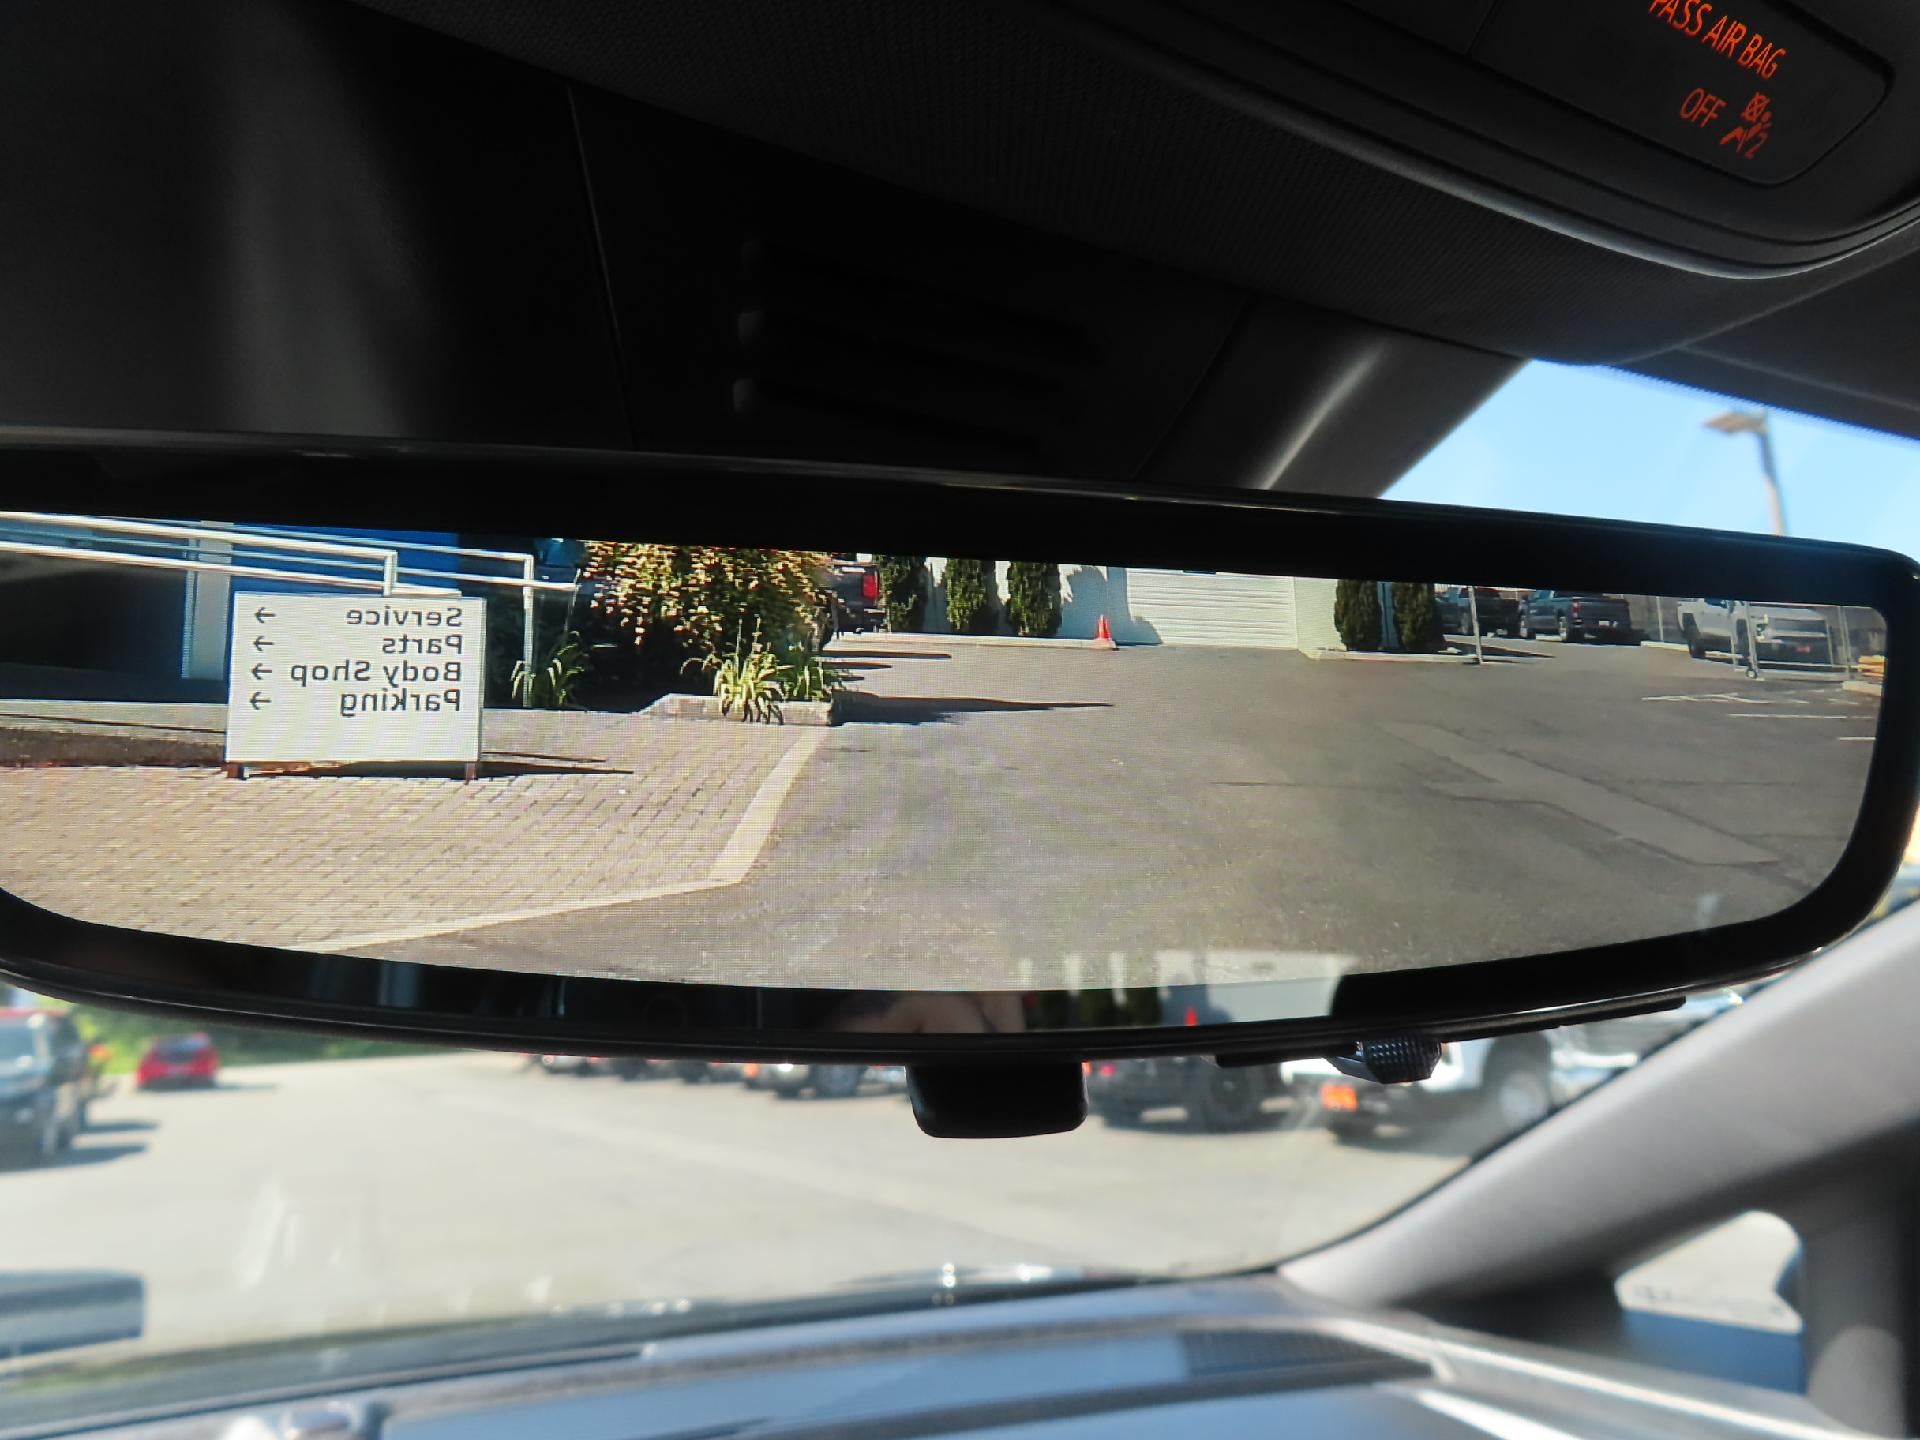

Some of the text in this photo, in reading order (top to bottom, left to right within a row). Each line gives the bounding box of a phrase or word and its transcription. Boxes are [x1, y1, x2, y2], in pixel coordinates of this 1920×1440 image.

[1702, 15, 1747, 57] AIR
[1737, 33, 1787, 79] BAG
[1680, 87, 1727, 128] OFF
